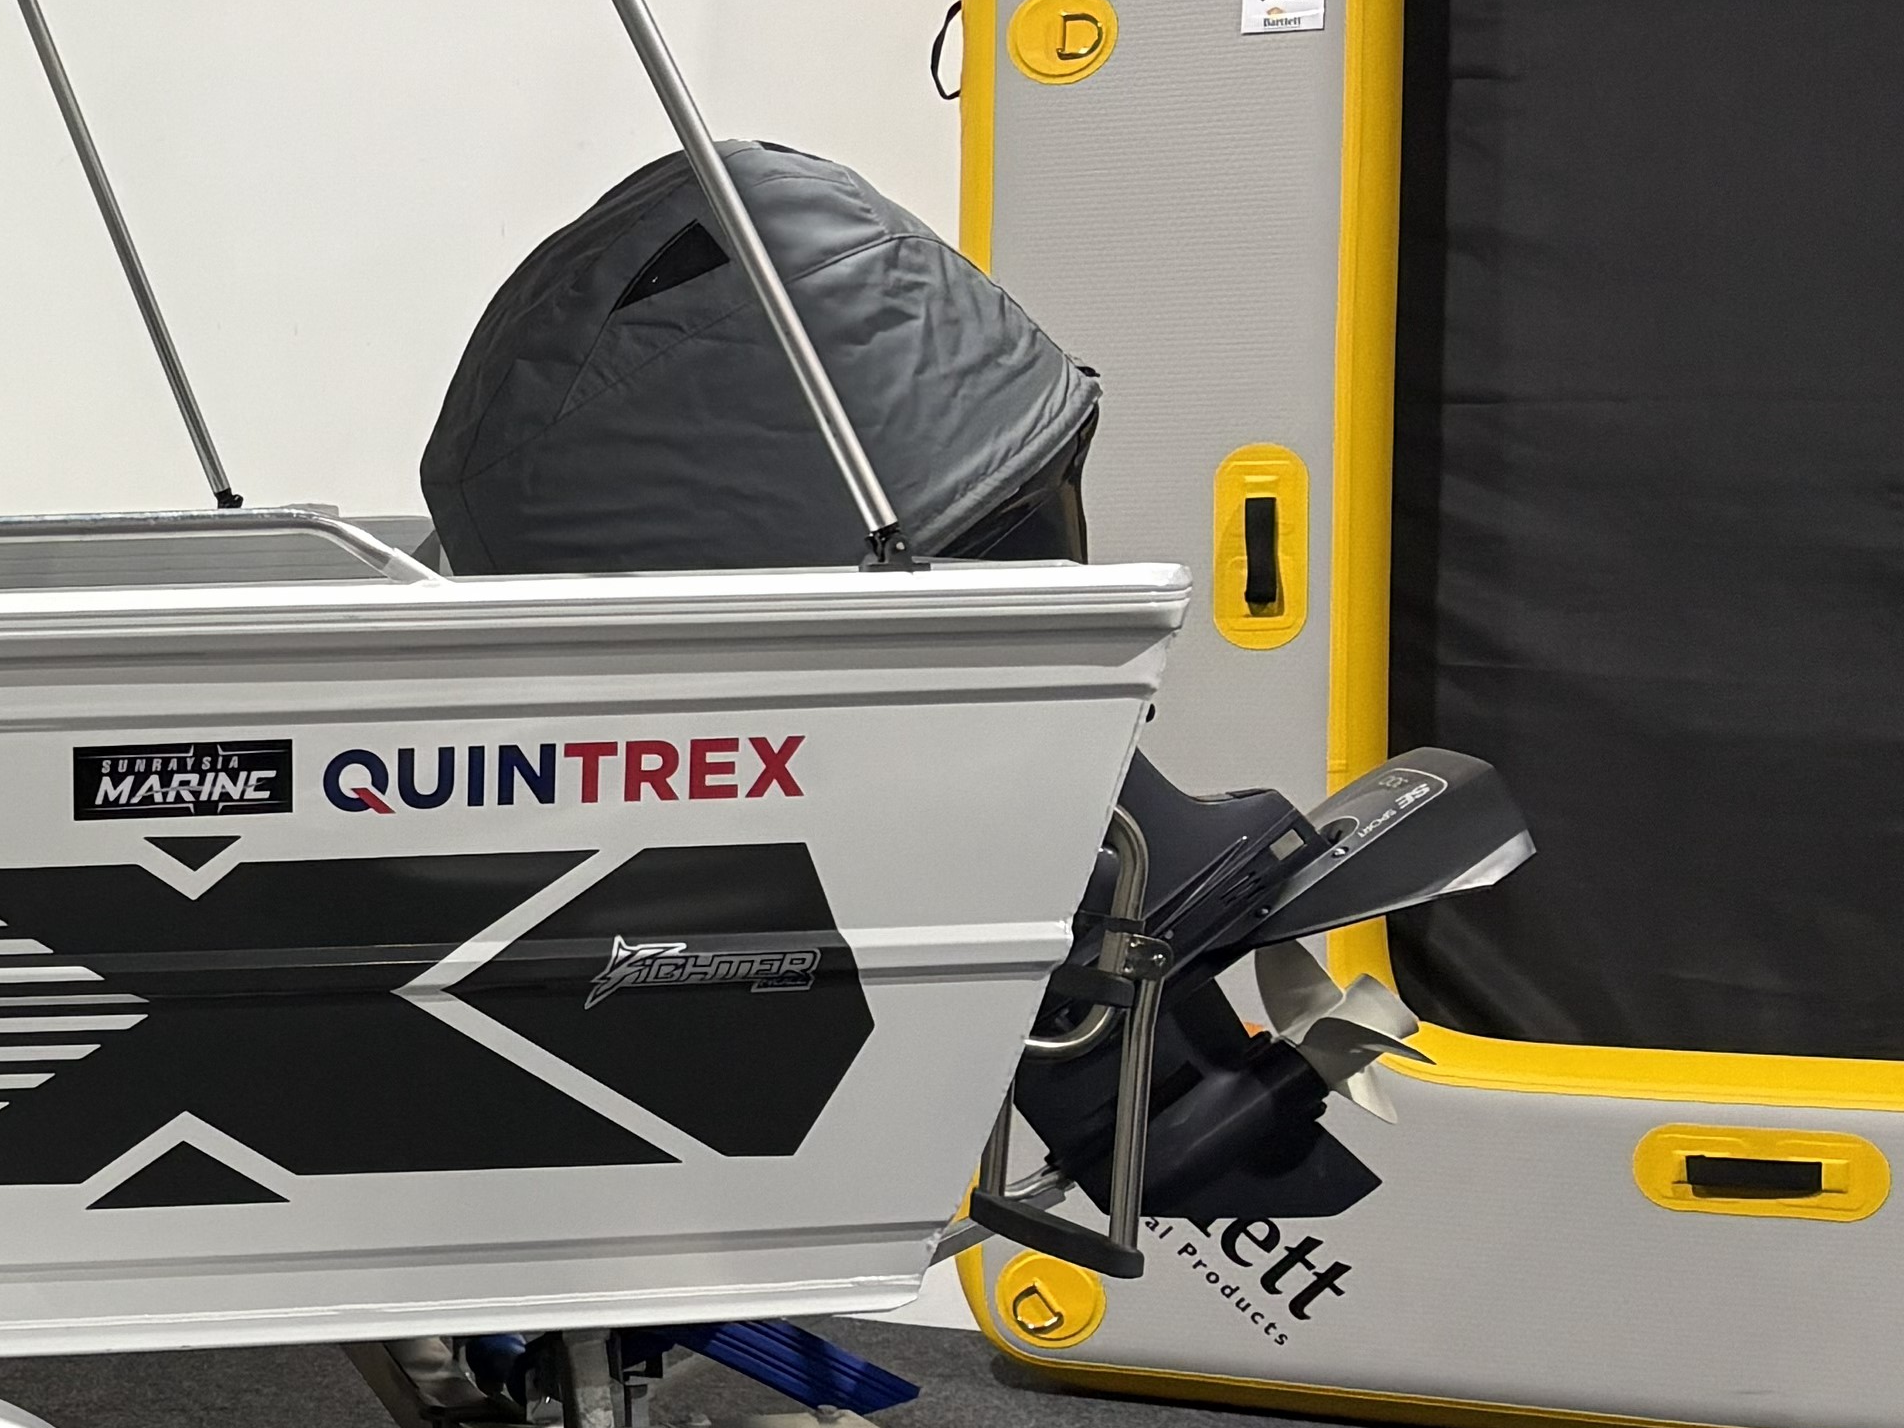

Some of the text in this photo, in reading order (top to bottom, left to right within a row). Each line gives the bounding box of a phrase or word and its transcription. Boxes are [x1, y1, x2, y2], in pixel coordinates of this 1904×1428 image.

[94, 769, 278, 806] MARINE
[101, 755, 239, 774] SUNRAYSIA
[322, 734, 807, 815] QUINTREX
[1394, 782, 1431, 810] SE
[584, 935, 822, 1009] FIGHTER
[1176, 1241, 1289, 1346] Products
